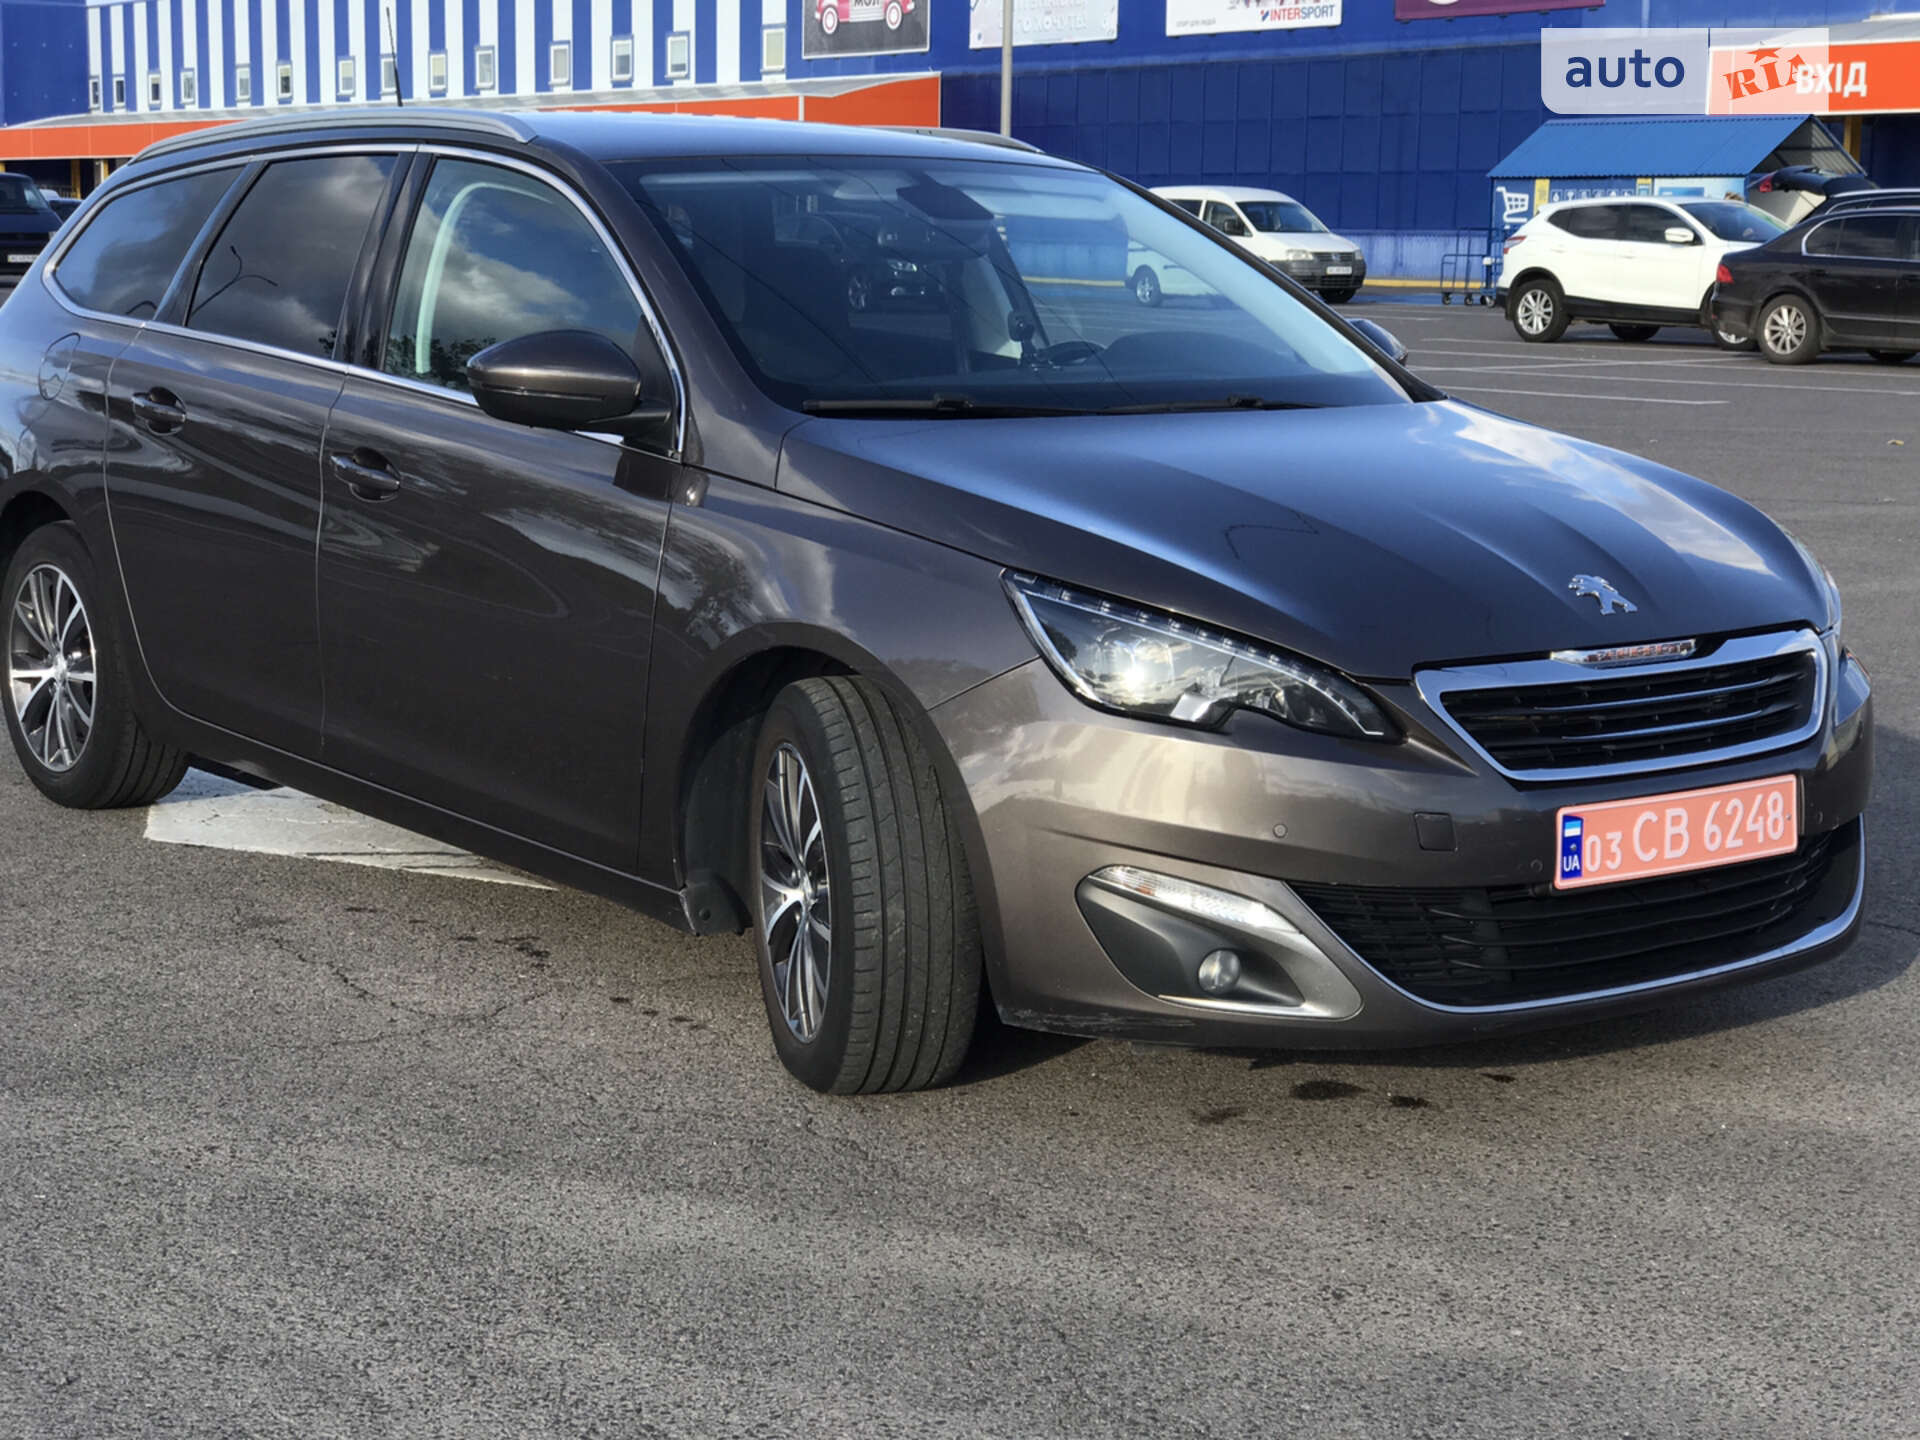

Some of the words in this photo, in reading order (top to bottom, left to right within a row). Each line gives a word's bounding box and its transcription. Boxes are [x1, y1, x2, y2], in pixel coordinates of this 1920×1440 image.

[1270, 5, 1335, 21] INTERSPORT
[1796, 62, 1868, 98] ВХІД
[1585, 831, 1623, 873] 03
[1633, 807, 1690, 863] CB
[1704, 791, 1784, 852] 6248
[1563, 855, 1580, 872] UA
